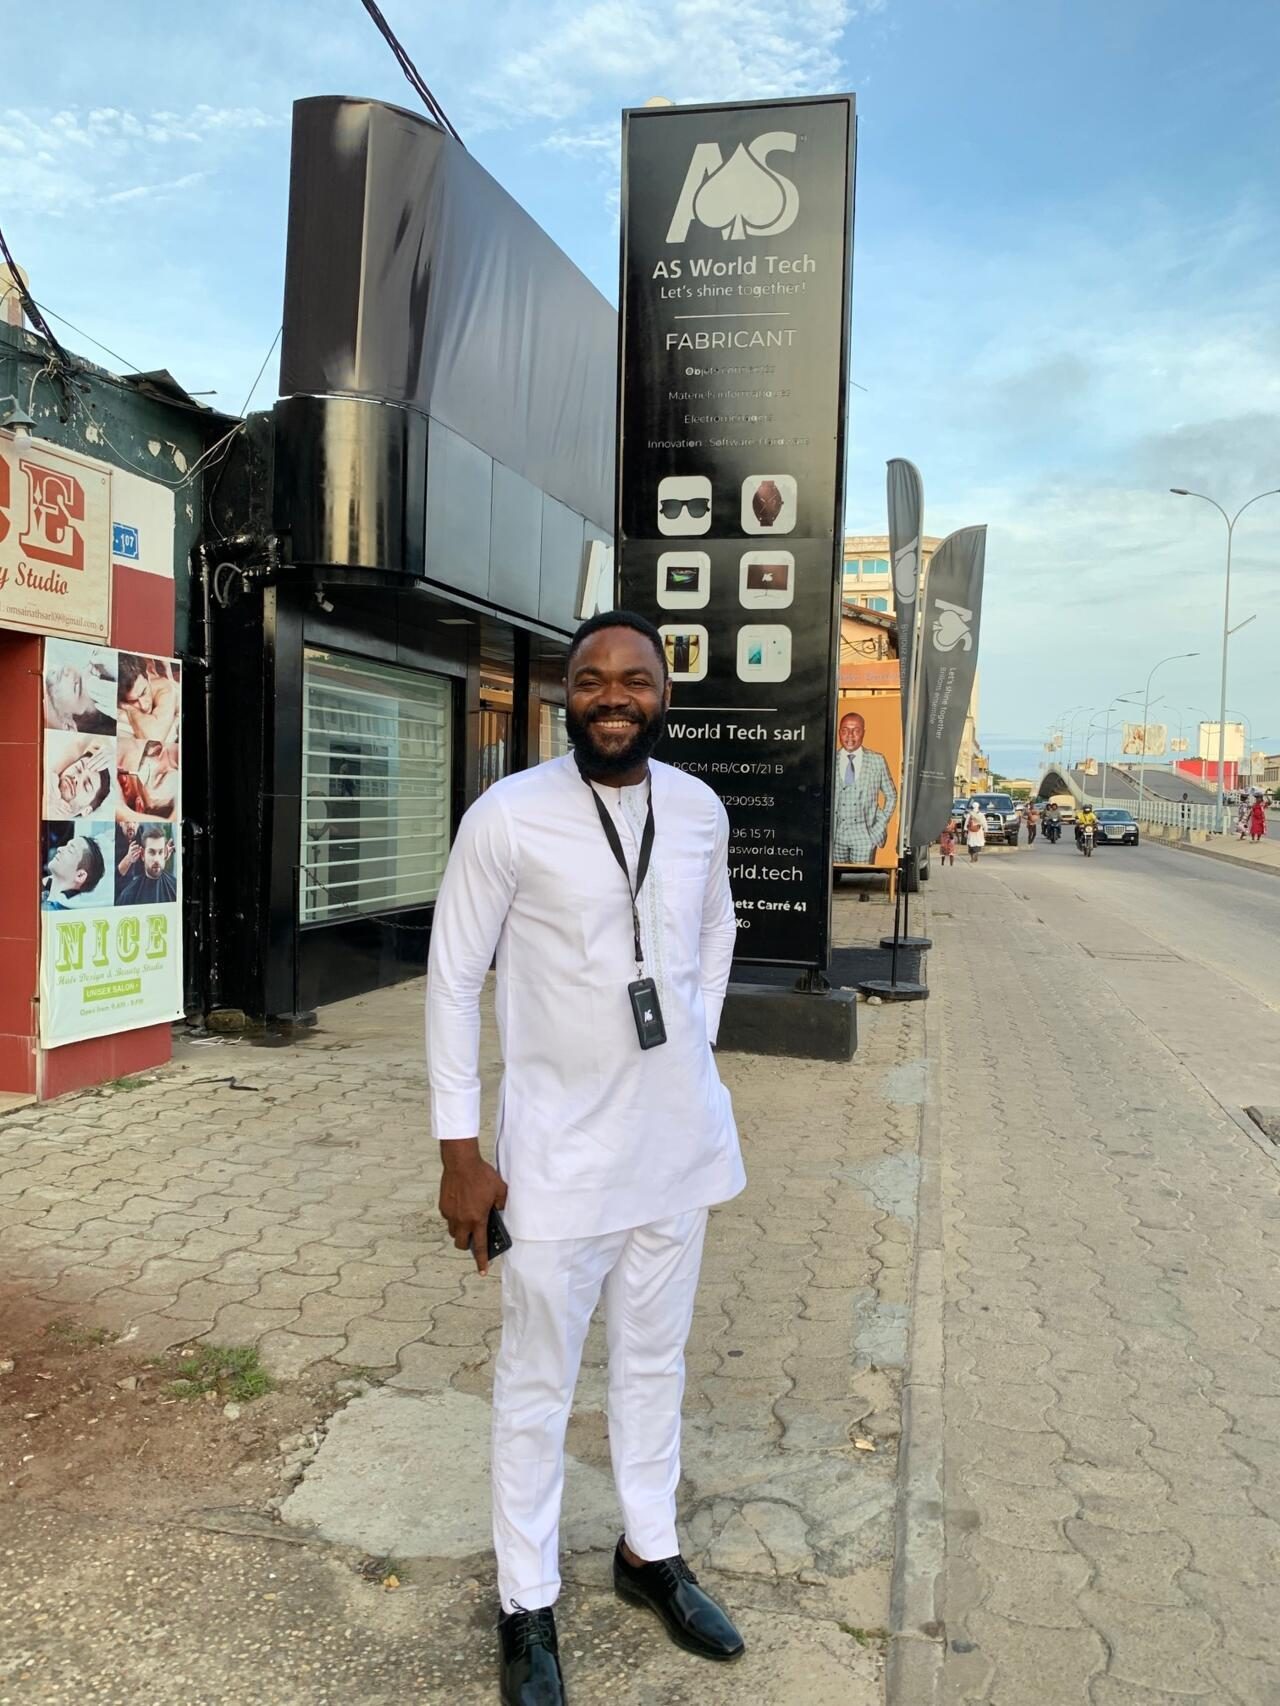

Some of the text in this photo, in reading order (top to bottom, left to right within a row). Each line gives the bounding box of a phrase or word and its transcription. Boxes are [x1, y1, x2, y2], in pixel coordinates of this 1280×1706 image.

[652, 254, 816, 279] AS World Tech
[660, 281, 807, 299] Let's shine together!
[665, 329, 798, 350] FABRICANT
[15, 561, 69, 595] Studio
[667, 723, 806, 741] World Tech sarl
[711, 762, 772, 775] RB/COT/21
[775, 764, 784, 775] B
[732, 828, 776, 840] 96 15 71
[757, 899, 791, 911] Carré
[793, 901, 807, 912] 41
[55, 914, 168, 972] NICE
